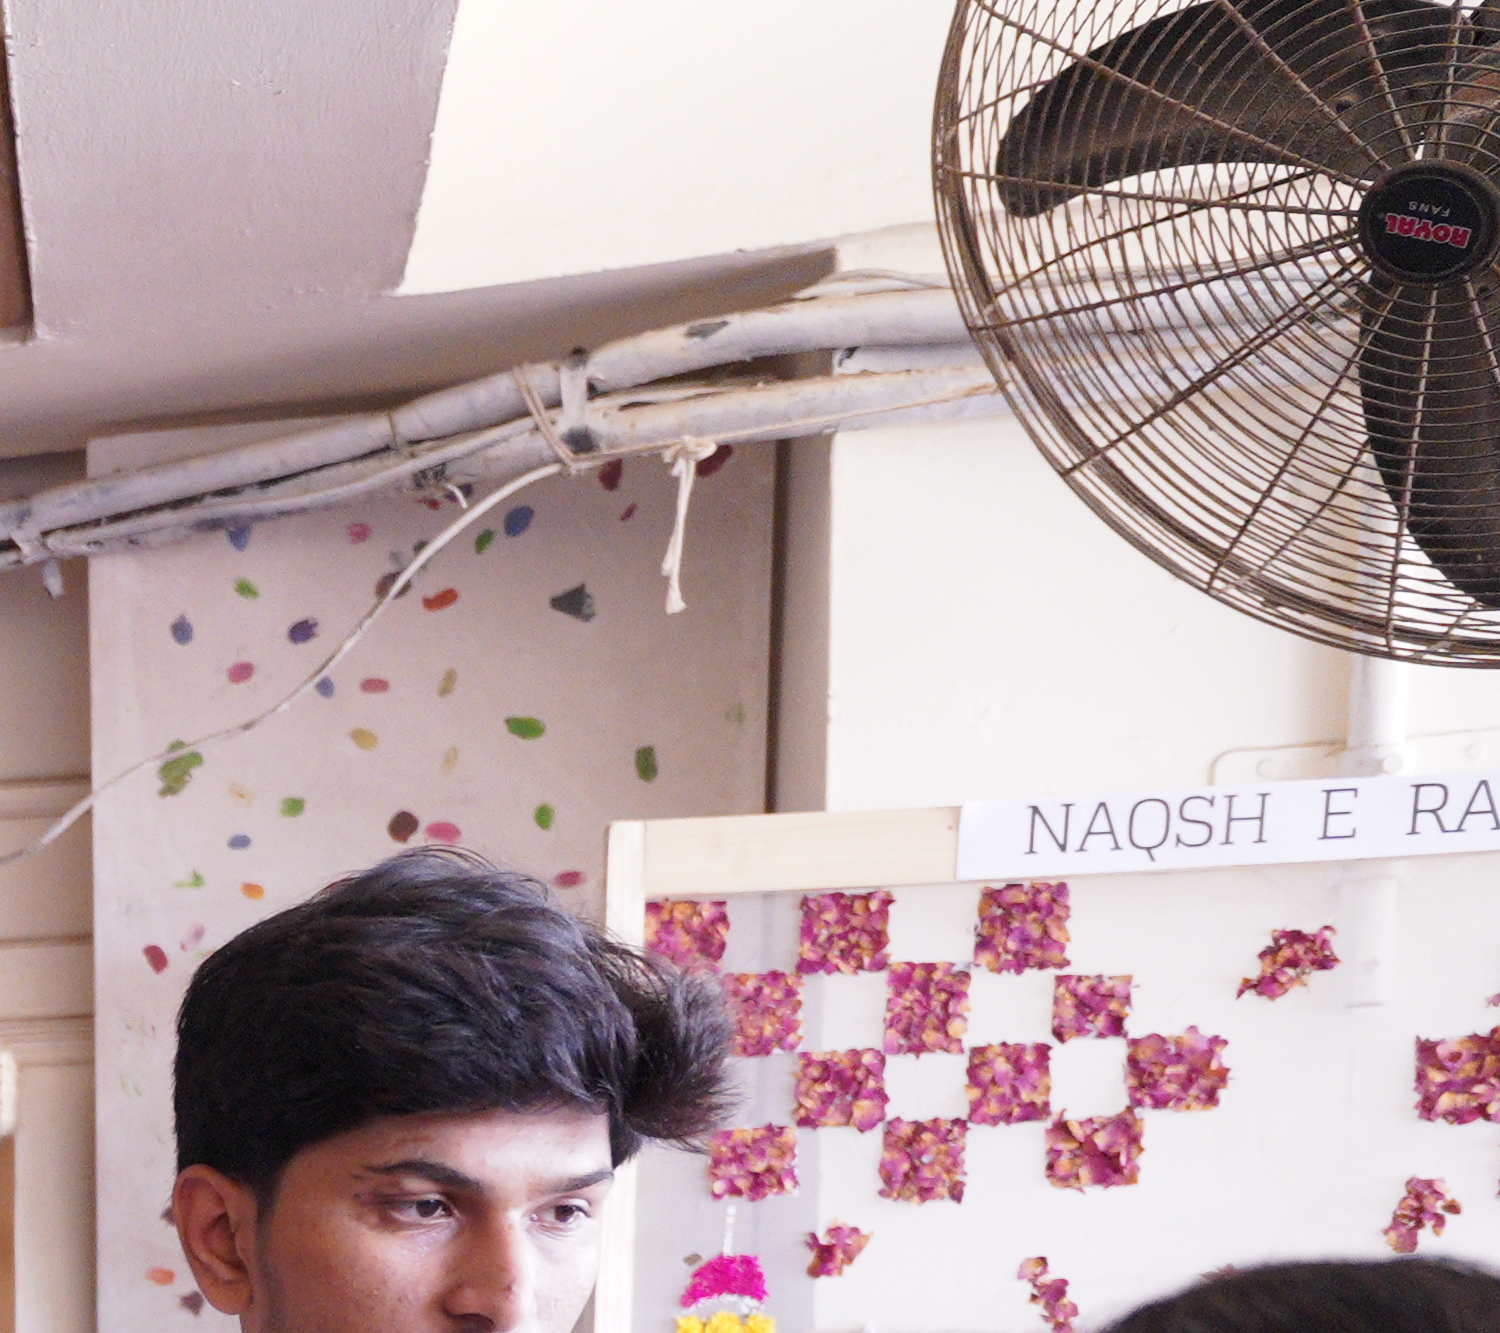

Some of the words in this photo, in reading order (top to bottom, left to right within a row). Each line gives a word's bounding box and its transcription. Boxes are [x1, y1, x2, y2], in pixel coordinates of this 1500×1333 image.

[1408, 200, 1451, 217] FANS
[1385, 212, 1473, 249] ROYAL
[1023, 792, 1271, 862] NAQSH
[1317, 787, 1359, 841] E
[1405, 779, 1500, 837] RA
